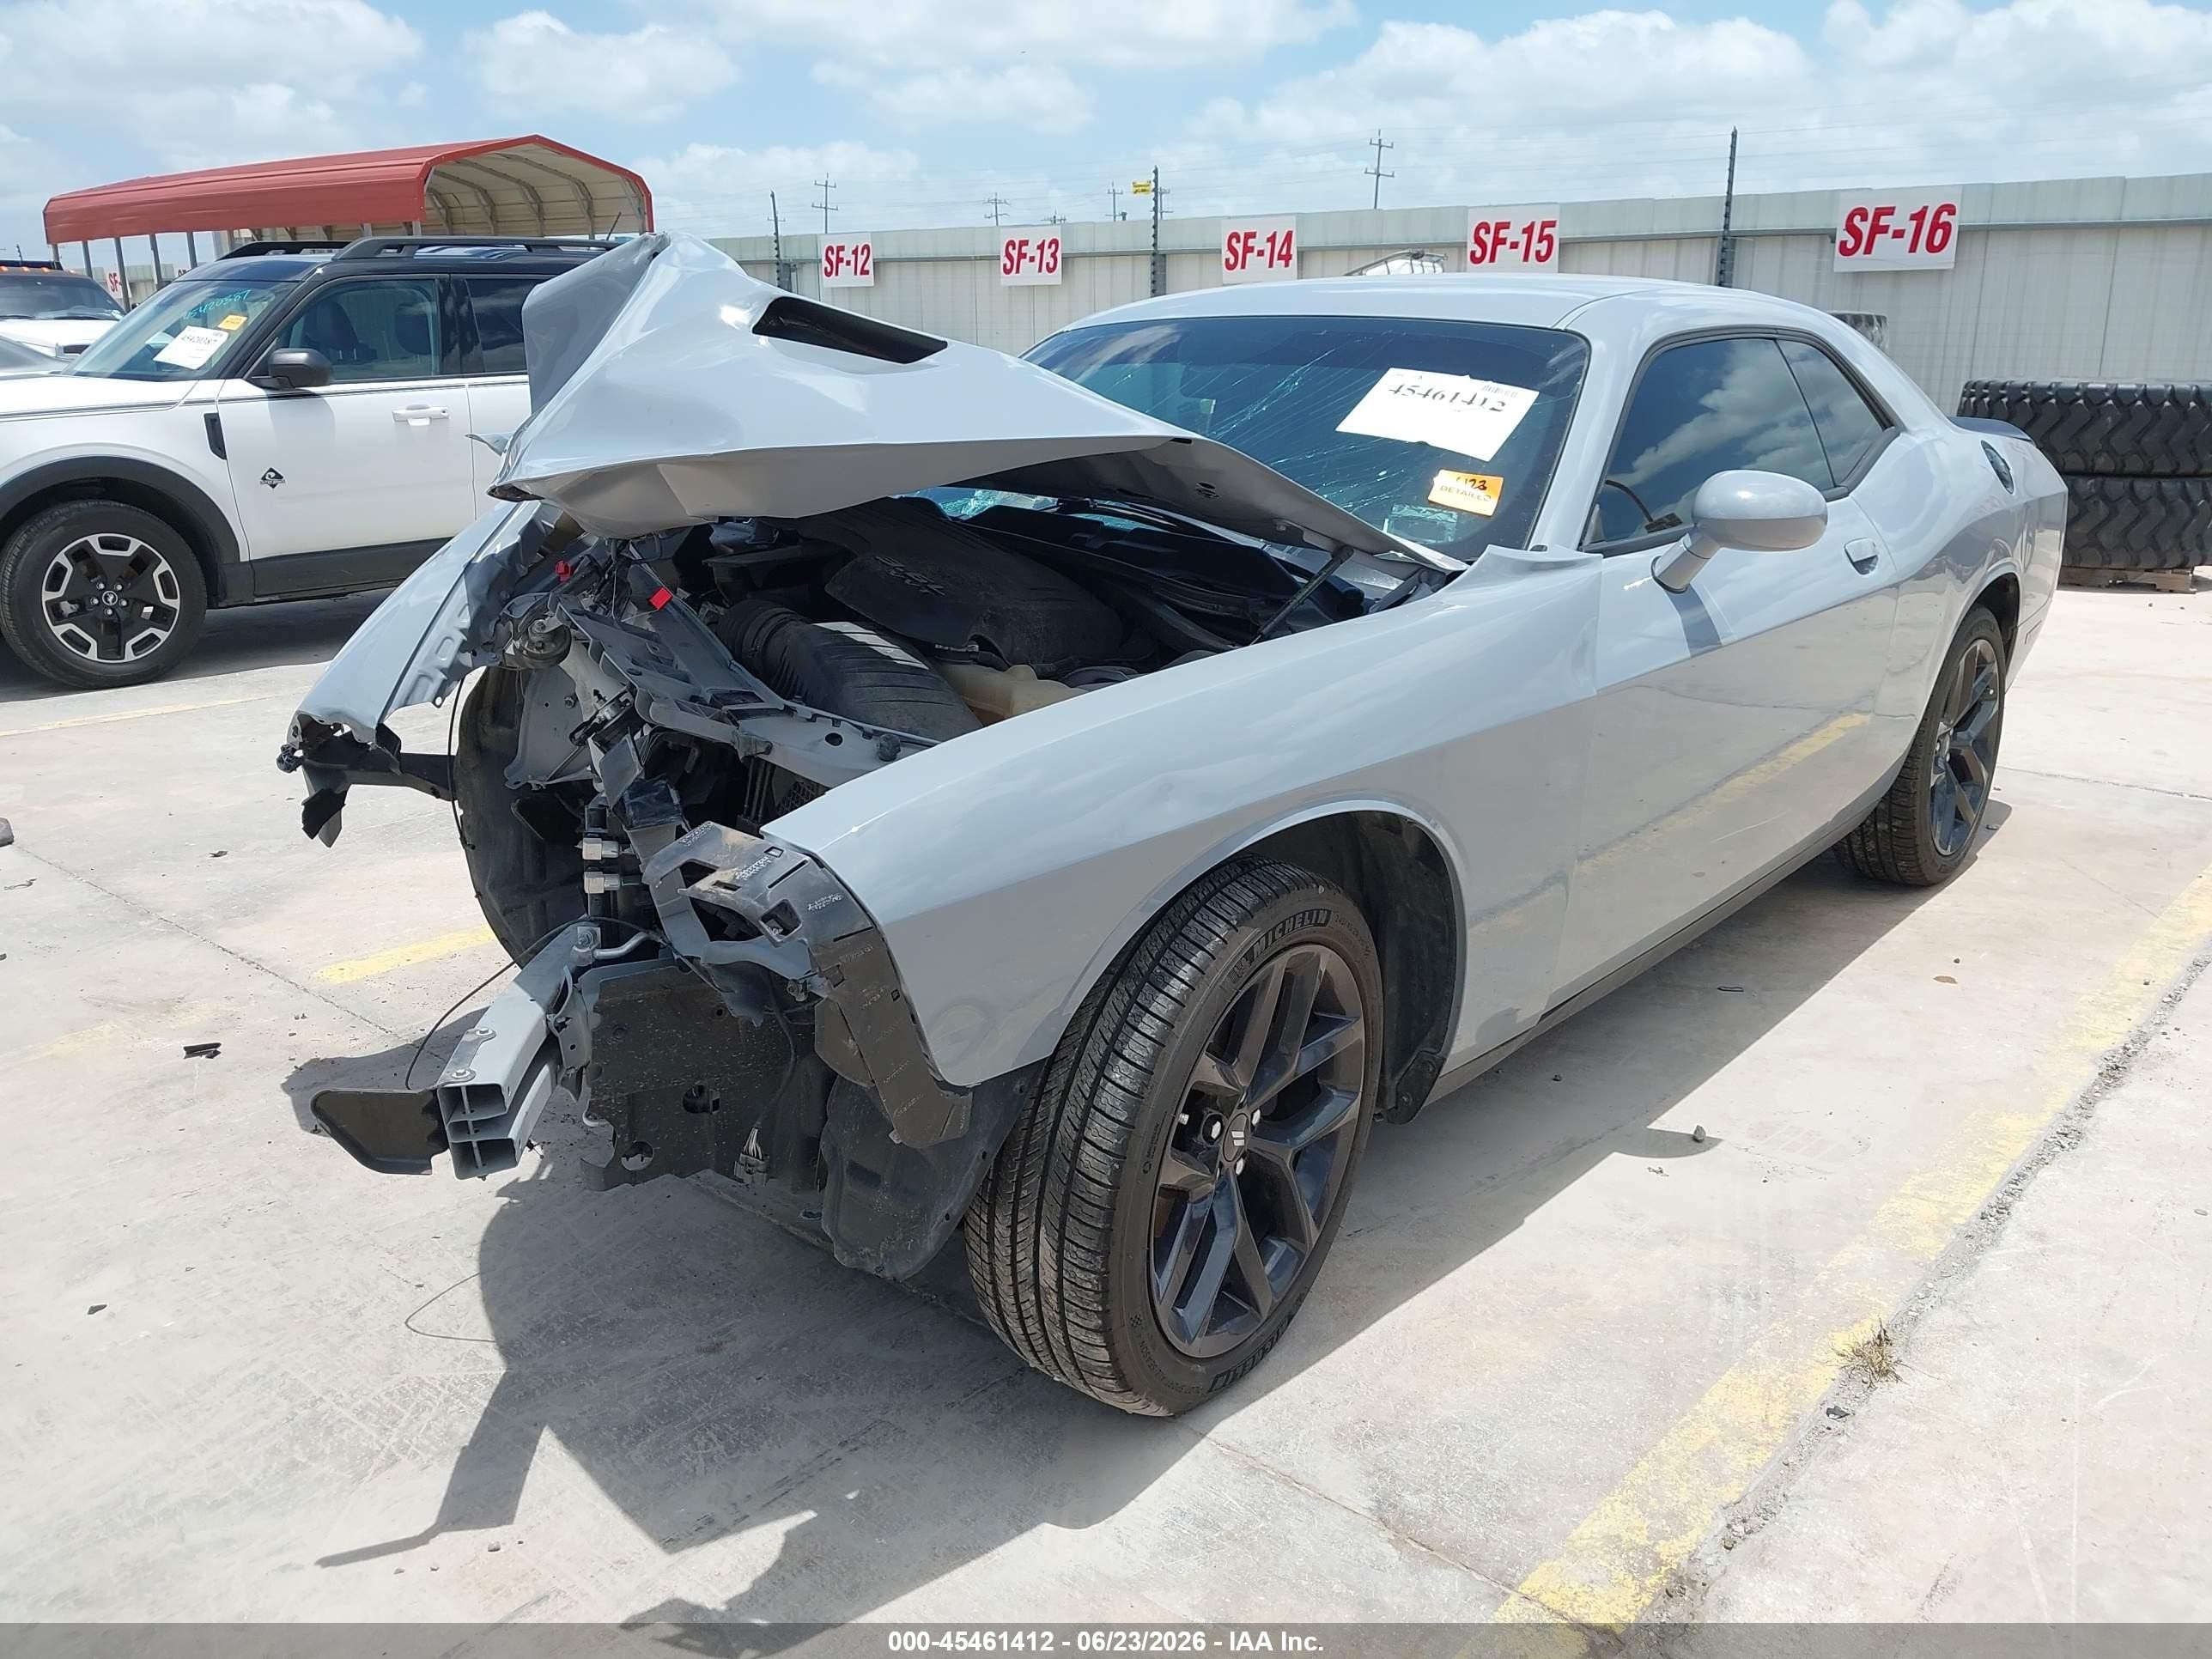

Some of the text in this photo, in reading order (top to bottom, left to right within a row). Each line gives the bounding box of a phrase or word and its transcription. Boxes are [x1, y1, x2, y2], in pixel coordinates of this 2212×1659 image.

[1224, 230, 1294, 271] SF-14
[1469, 220, 1557, 264] SF-15
[1838, 204, 1956, 256] SF-16
[823, 244, 871, 277] SF-12
[1002, 238, 1060, 275] SF-13
[1253, 909, 1328, 960] MICHELIN
